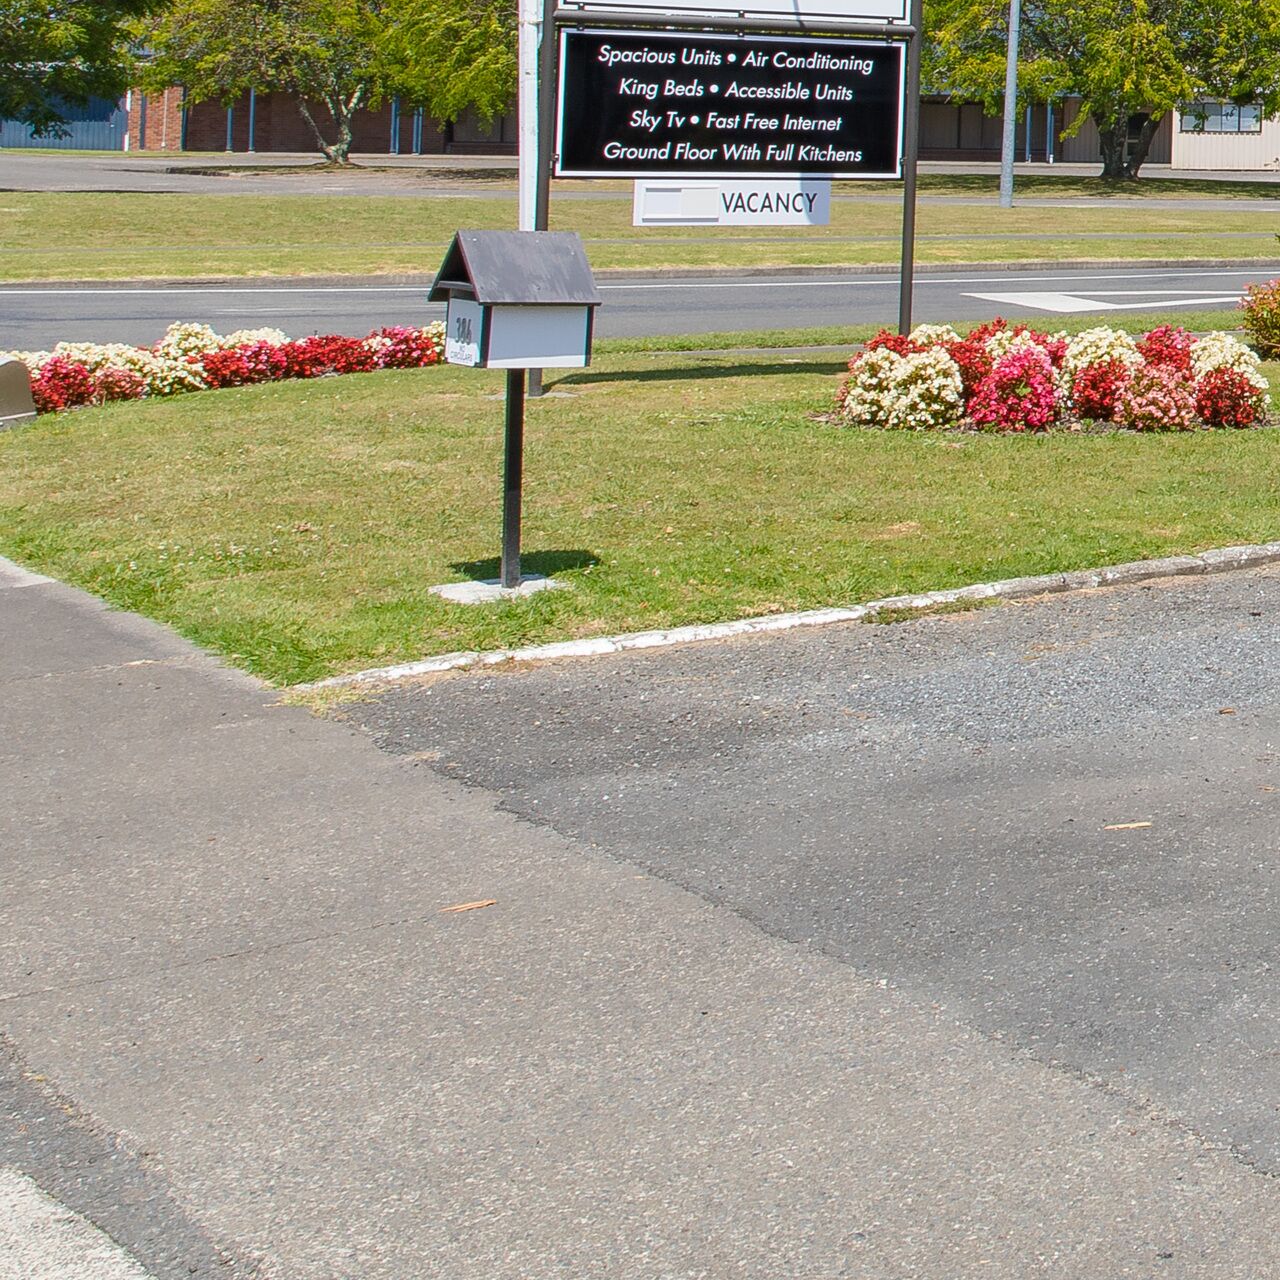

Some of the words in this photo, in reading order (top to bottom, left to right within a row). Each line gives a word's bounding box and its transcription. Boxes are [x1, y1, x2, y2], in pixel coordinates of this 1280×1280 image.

[598, 45, 676, 66] Spacious
[681, 48, 722, 66] Units
[742, 51, 769, 67] Air
[773, 52, 874, 75] Conditioning
[619, 78, 658, 99] King
[664, 79, 704, 97] Beds
[725, 81, 810, 99] Accessible
[815, 84, 853, 101] Units
[630, 109, 661, 131] Sky
[666, 111, 686, 128] Tv
[706, 112, 740, 129] Fast
[744, 113, 779, 130] Free
[783, 115, 842, 131] Internet
[603, 142, 671, 160] Ground
[674, 142, 717, 160] Floor
[722, 143, 761, 161] With
[766, 143, 794, 161] Full
[798, 145, 862, 162] Kitchens
[722, 192, 818, 213] VACANCY
